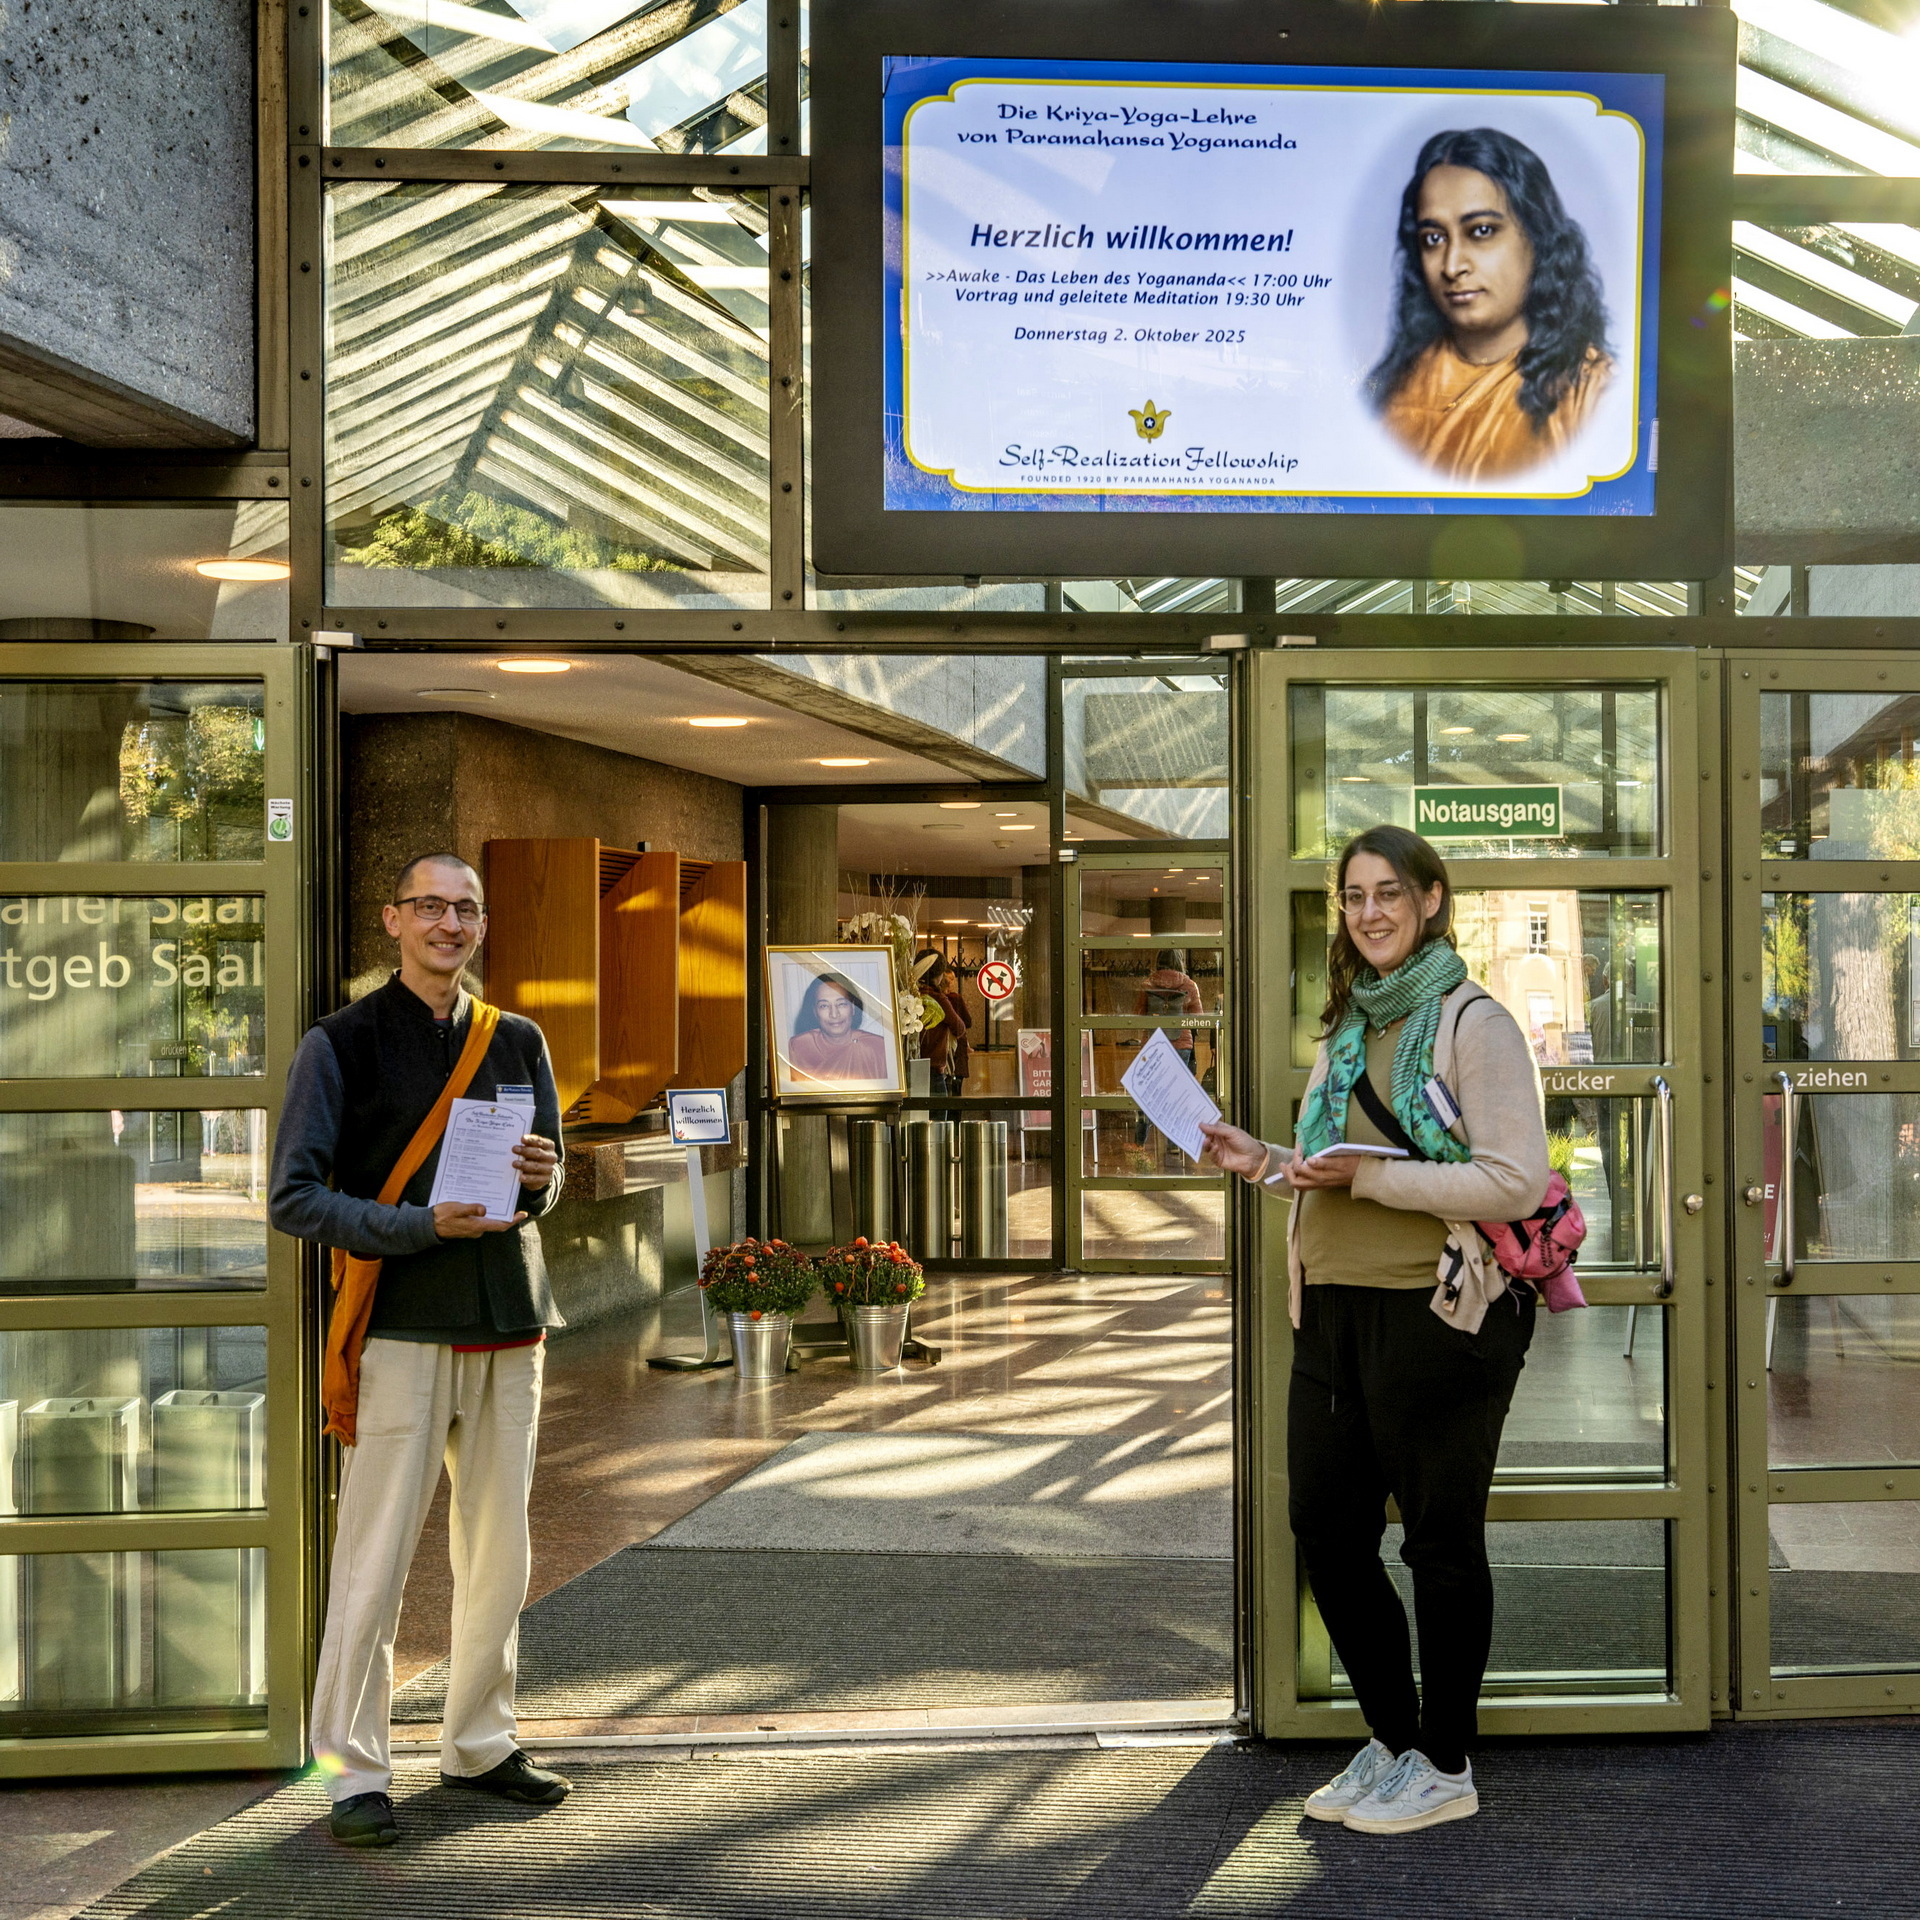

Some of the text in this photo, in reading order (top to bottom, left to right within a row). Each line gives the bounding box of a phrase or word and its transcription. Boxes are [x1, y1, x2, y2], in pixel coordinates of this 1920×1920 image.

[997, 103, 1258, 126] Die Kriya-Yoga-Lehre
[957, 128, 1298, 152] von Paramahansa Yogananda
[970, 224, 1294, 252] Herzlich willkommen!
[926, 269, 1000, 283] >>Awake
[1015, 270, 1046, 284] Das
[1051, 270, 1099, 284] Leben
[1104, 271, 1131, 285] des
[1137, 272, 1247, 289] Yogananda<<
[1253, 273, 1298, 287] 17:00
[1303, 274, 1333, 288] Uhr
[955, 288, 1305, 307] Vortrag und geleitete Meditation 19:30 Uhr
[1014, 327, 1247, 344] Donnerstag 2. Oktober 2025
[998, 444, 1299, 473] Self-Realization Fellowship
[1020, 475, 1072, 483] FOUNDED
[1077, 475, 1102, 483] 1920
[1124, 476, 1204, 484] PARAMAHANSA
[1209, 477, 1276, 485] YOGANANDA
[1419, 799, 1555, 828] Notausgang
[0, 941, 262, 1001] tgeb Saal
[1181, 1018, 1211, 1027] ziehen
[161, 1043, 187, 1057] drücken
[1033, 1069, 1051, 1078] BITT
[1542, 1070, 1615, 1091] rücker
[1796, 1068, 1868, 1088] ziehen
[1033, 1079, 1051, 1088] GAR
[1033, 1089, 1051, 1097] ABG
[681, 1104, 716, 1114] Herzlich
[676, 1116, 723, 1125] willkommen
